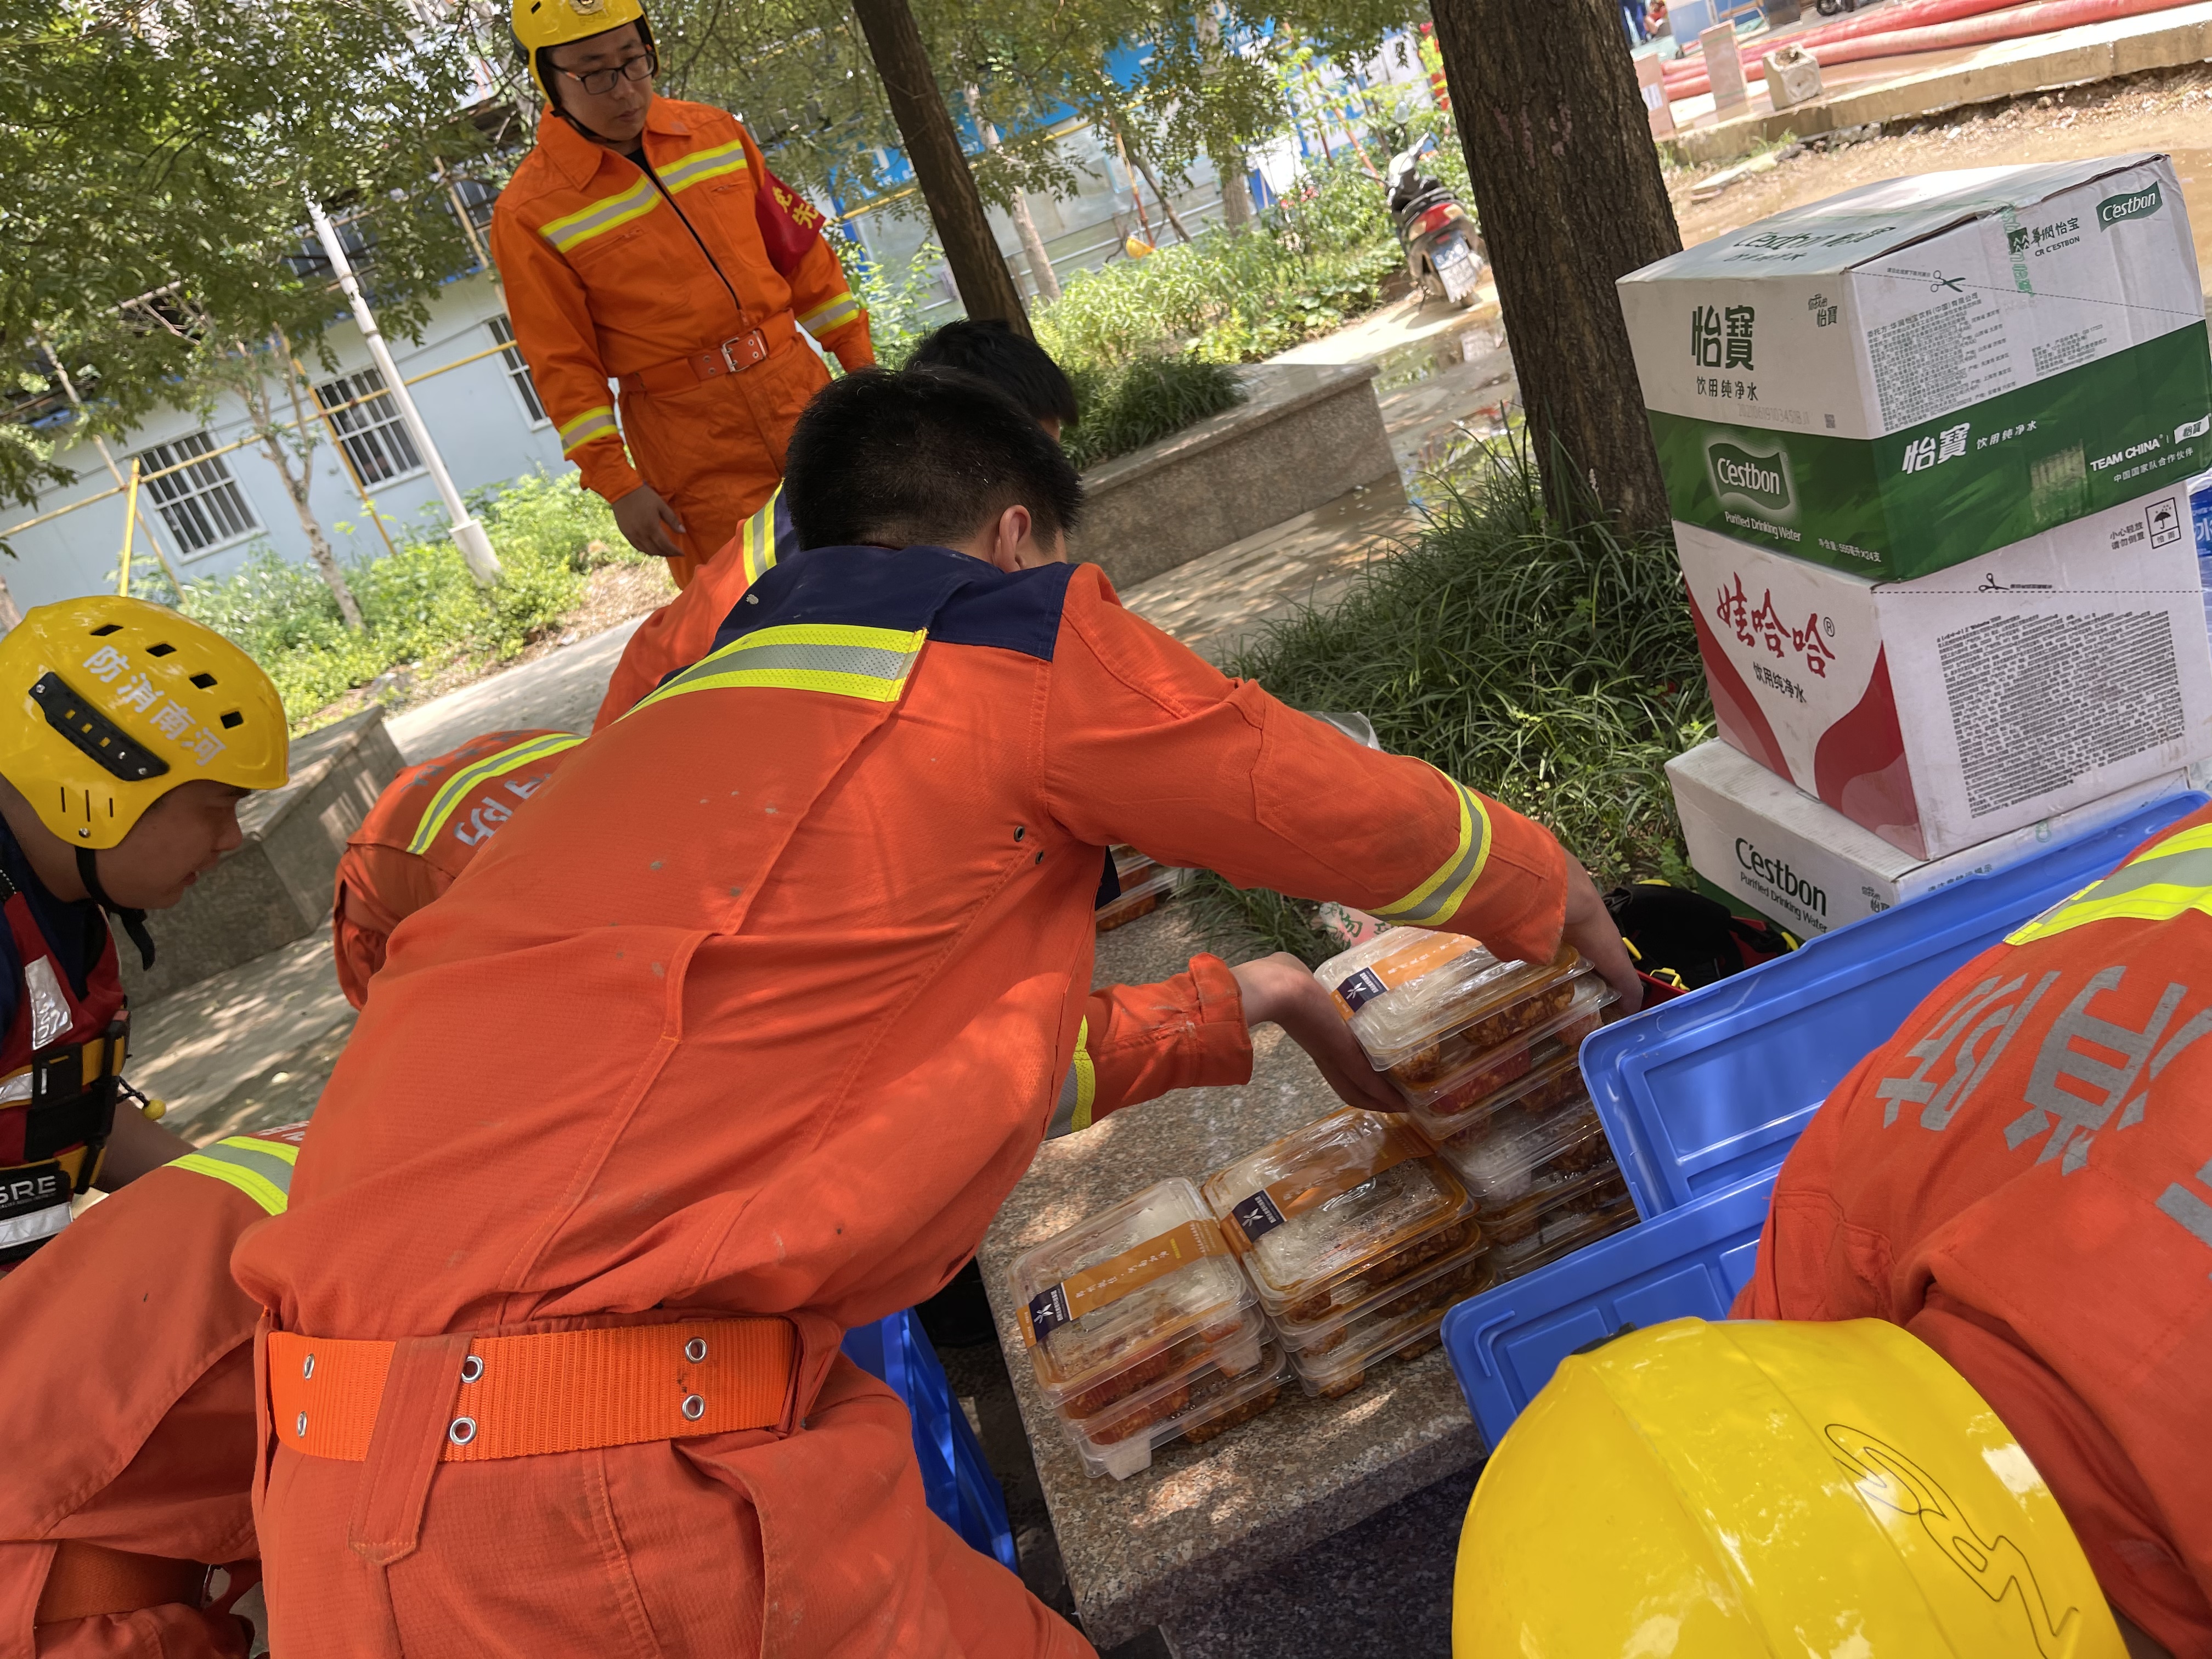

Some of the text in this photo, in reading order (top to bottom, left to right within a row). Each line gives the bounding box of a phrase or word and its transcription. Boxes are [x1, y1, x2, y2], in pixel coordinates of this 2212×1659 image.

[2102, 191, 2157, 222] C'estbon
[1696, 376, 1758, 401] 饮用纯净水
[1976, 420, 2037, 450] 饮用纯净水
[2090, 438, 2160, 471] TEAM CHINA
[1717, 457, 1780, 495] C'estbon
[1725, 511, 1802, 542] Purified Drinking Water
[1717, 571, 1836, 678] 娃哈哈
[1753, 662, 1807, 703] 饮用纯净水
[1735, 837, 1827, 917] C'estbon
[1740, 871, 1828, 933] Purified Drinking Water
